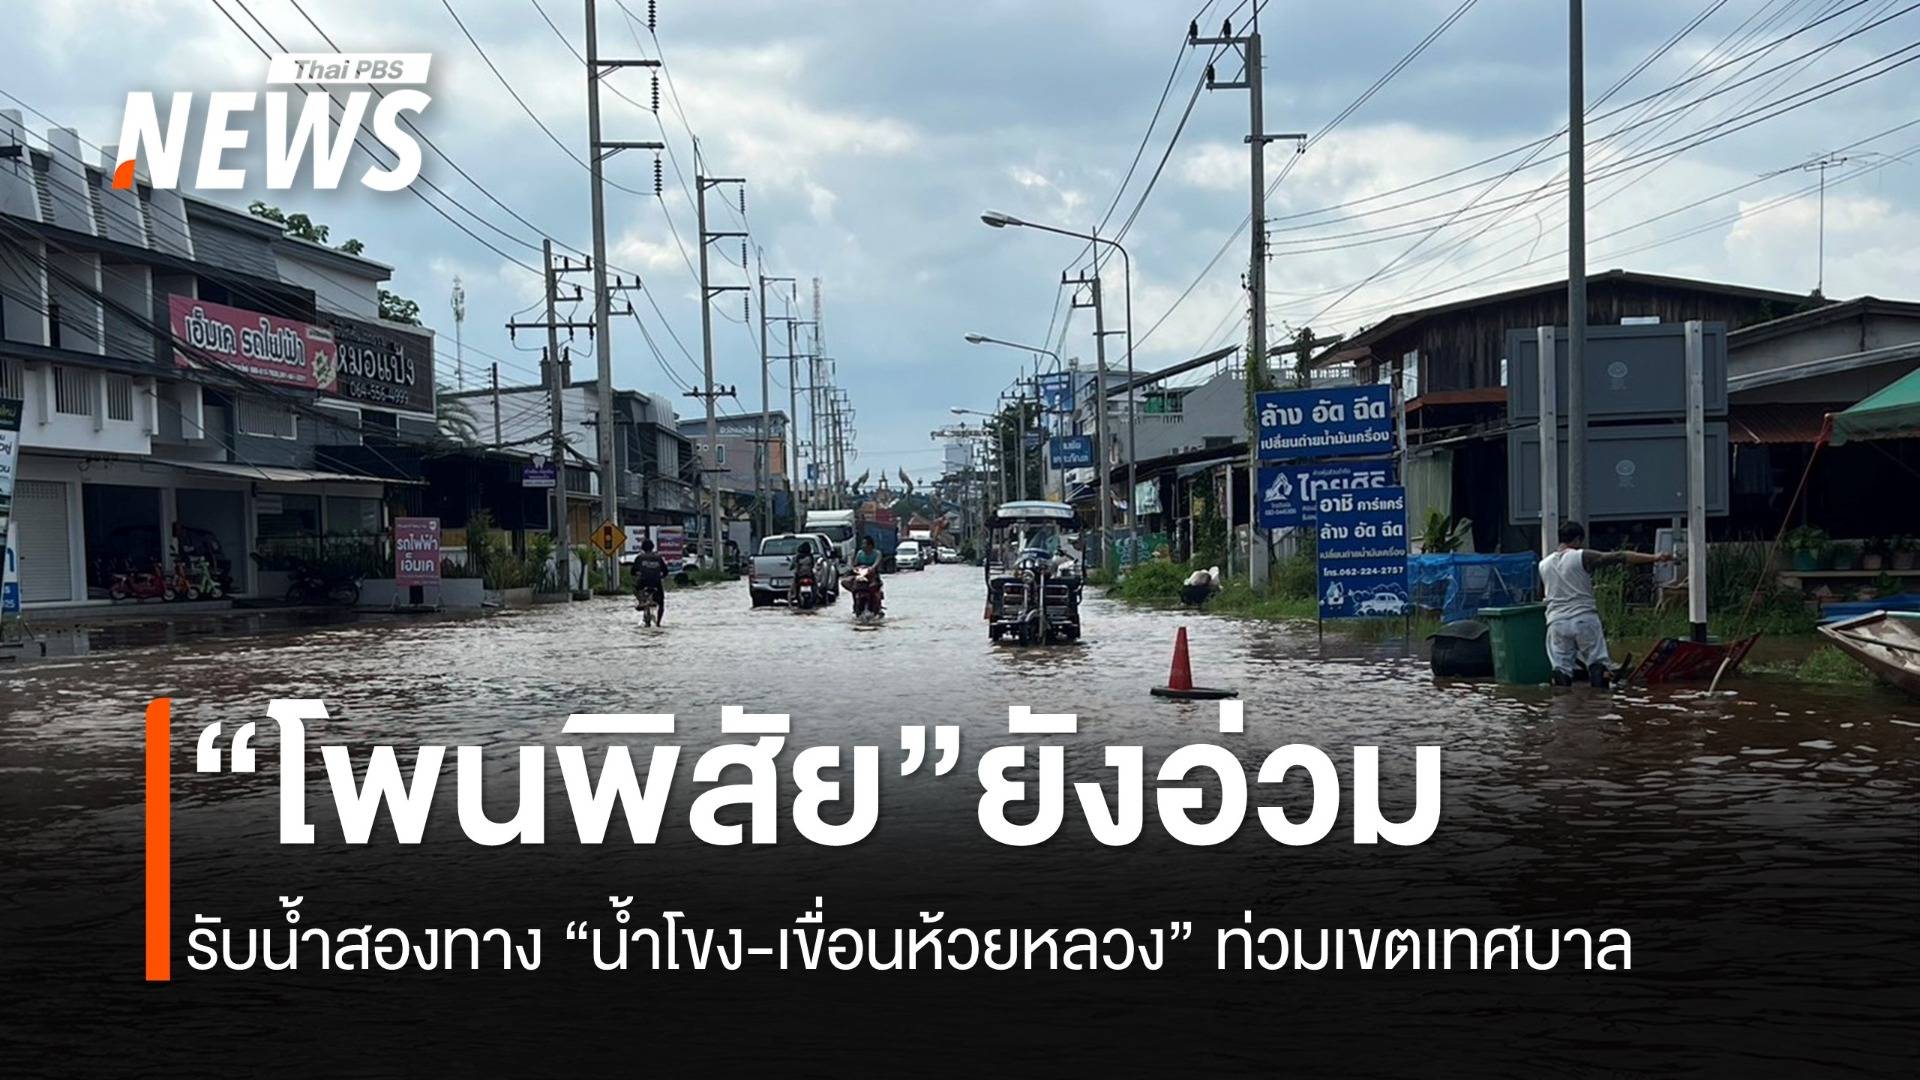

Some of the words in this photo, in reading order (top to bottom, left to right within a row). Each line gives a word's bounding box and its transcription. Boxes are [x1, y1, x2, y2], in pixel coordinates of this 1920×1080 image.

[1261, 402, 1303, 427] ล้าง
[1312, 399, 1345, 424] อัด
[1354, 396, 1386, 420] ฉีด
[1320, 522, 1349, 540] ล้าง
[1354, 521, 1377, 538] อัด
[1382, 520, 1404, 537] ฉีด
